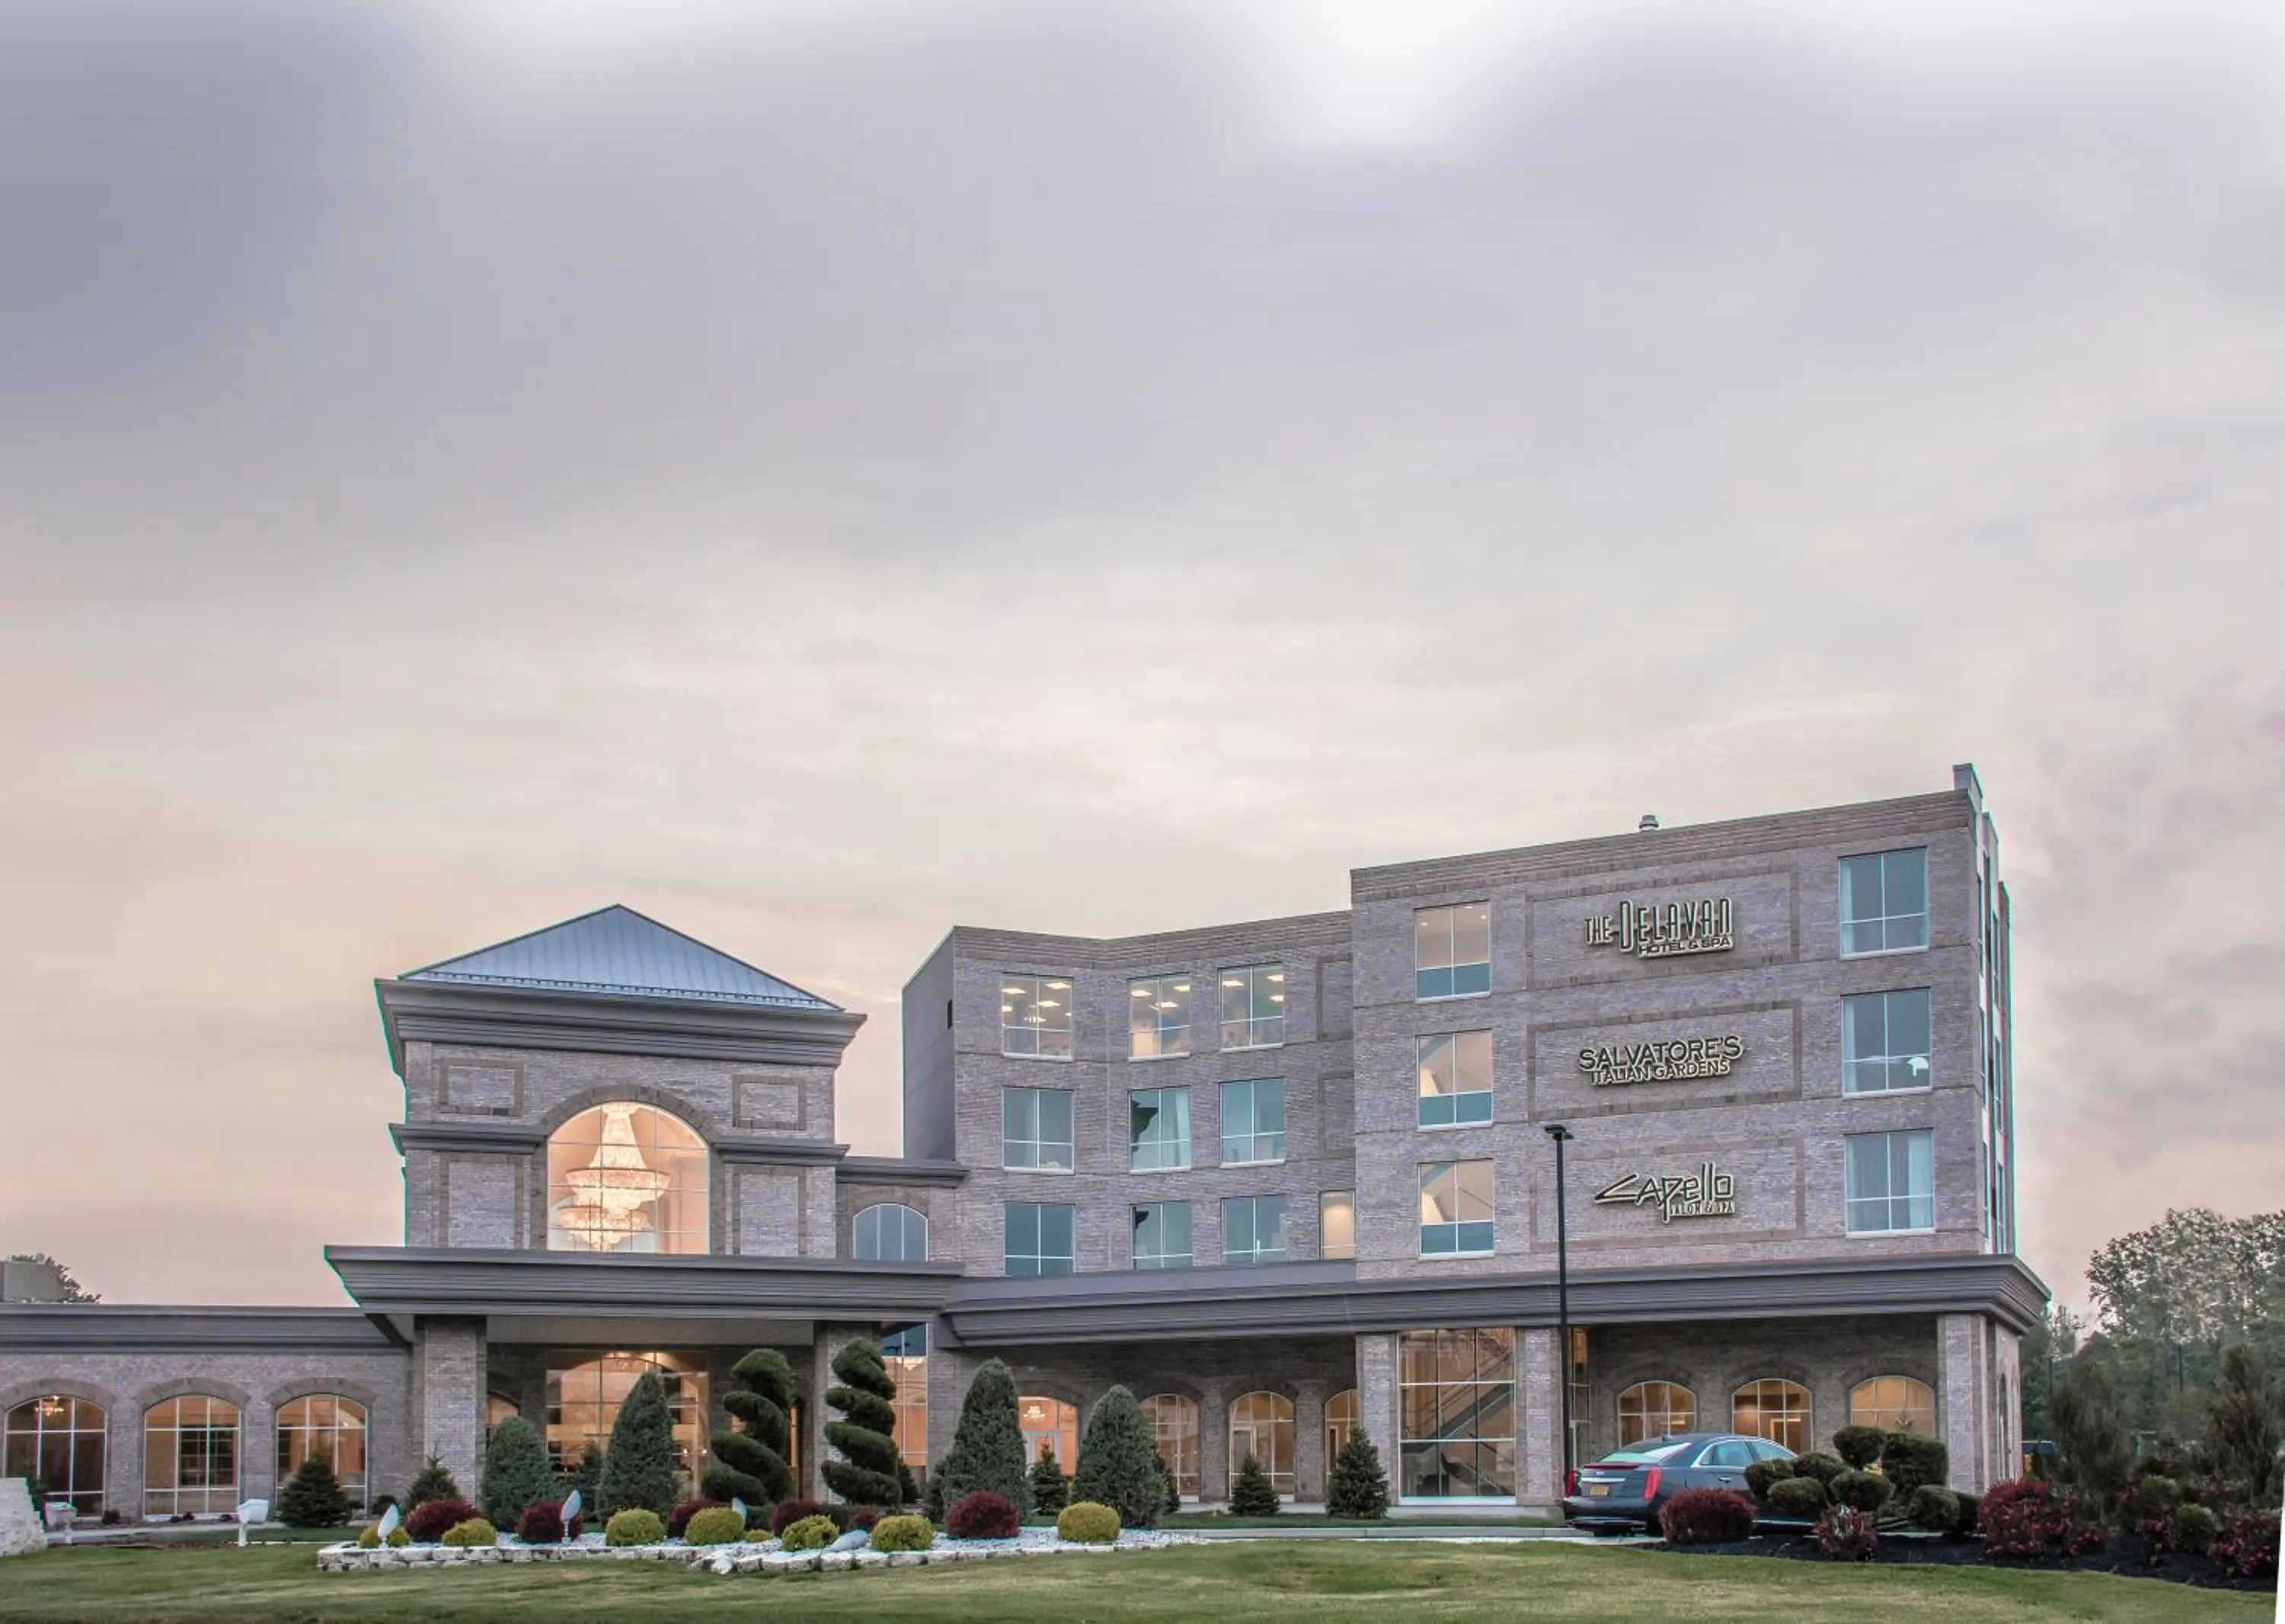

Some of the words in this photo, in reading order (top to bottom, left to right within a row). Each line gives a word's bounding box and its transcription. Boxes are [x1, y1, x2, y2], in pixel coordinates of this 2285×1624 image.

[1584, 916, 1612, 945] THE
[1619, 898, 1733, 951] DELAVAN
[1638, 941, 1686, 956] HOTEL
[1688, 939, 1700, 951] &
[1701, 935, 1733, 951] SPA
[1578, 1035, 1744, 1072] SALVATORE'S
[1591, 1065, 1651, 1085] ITALIAN
[1653, 1059, 1731, 1080] GARDENS
